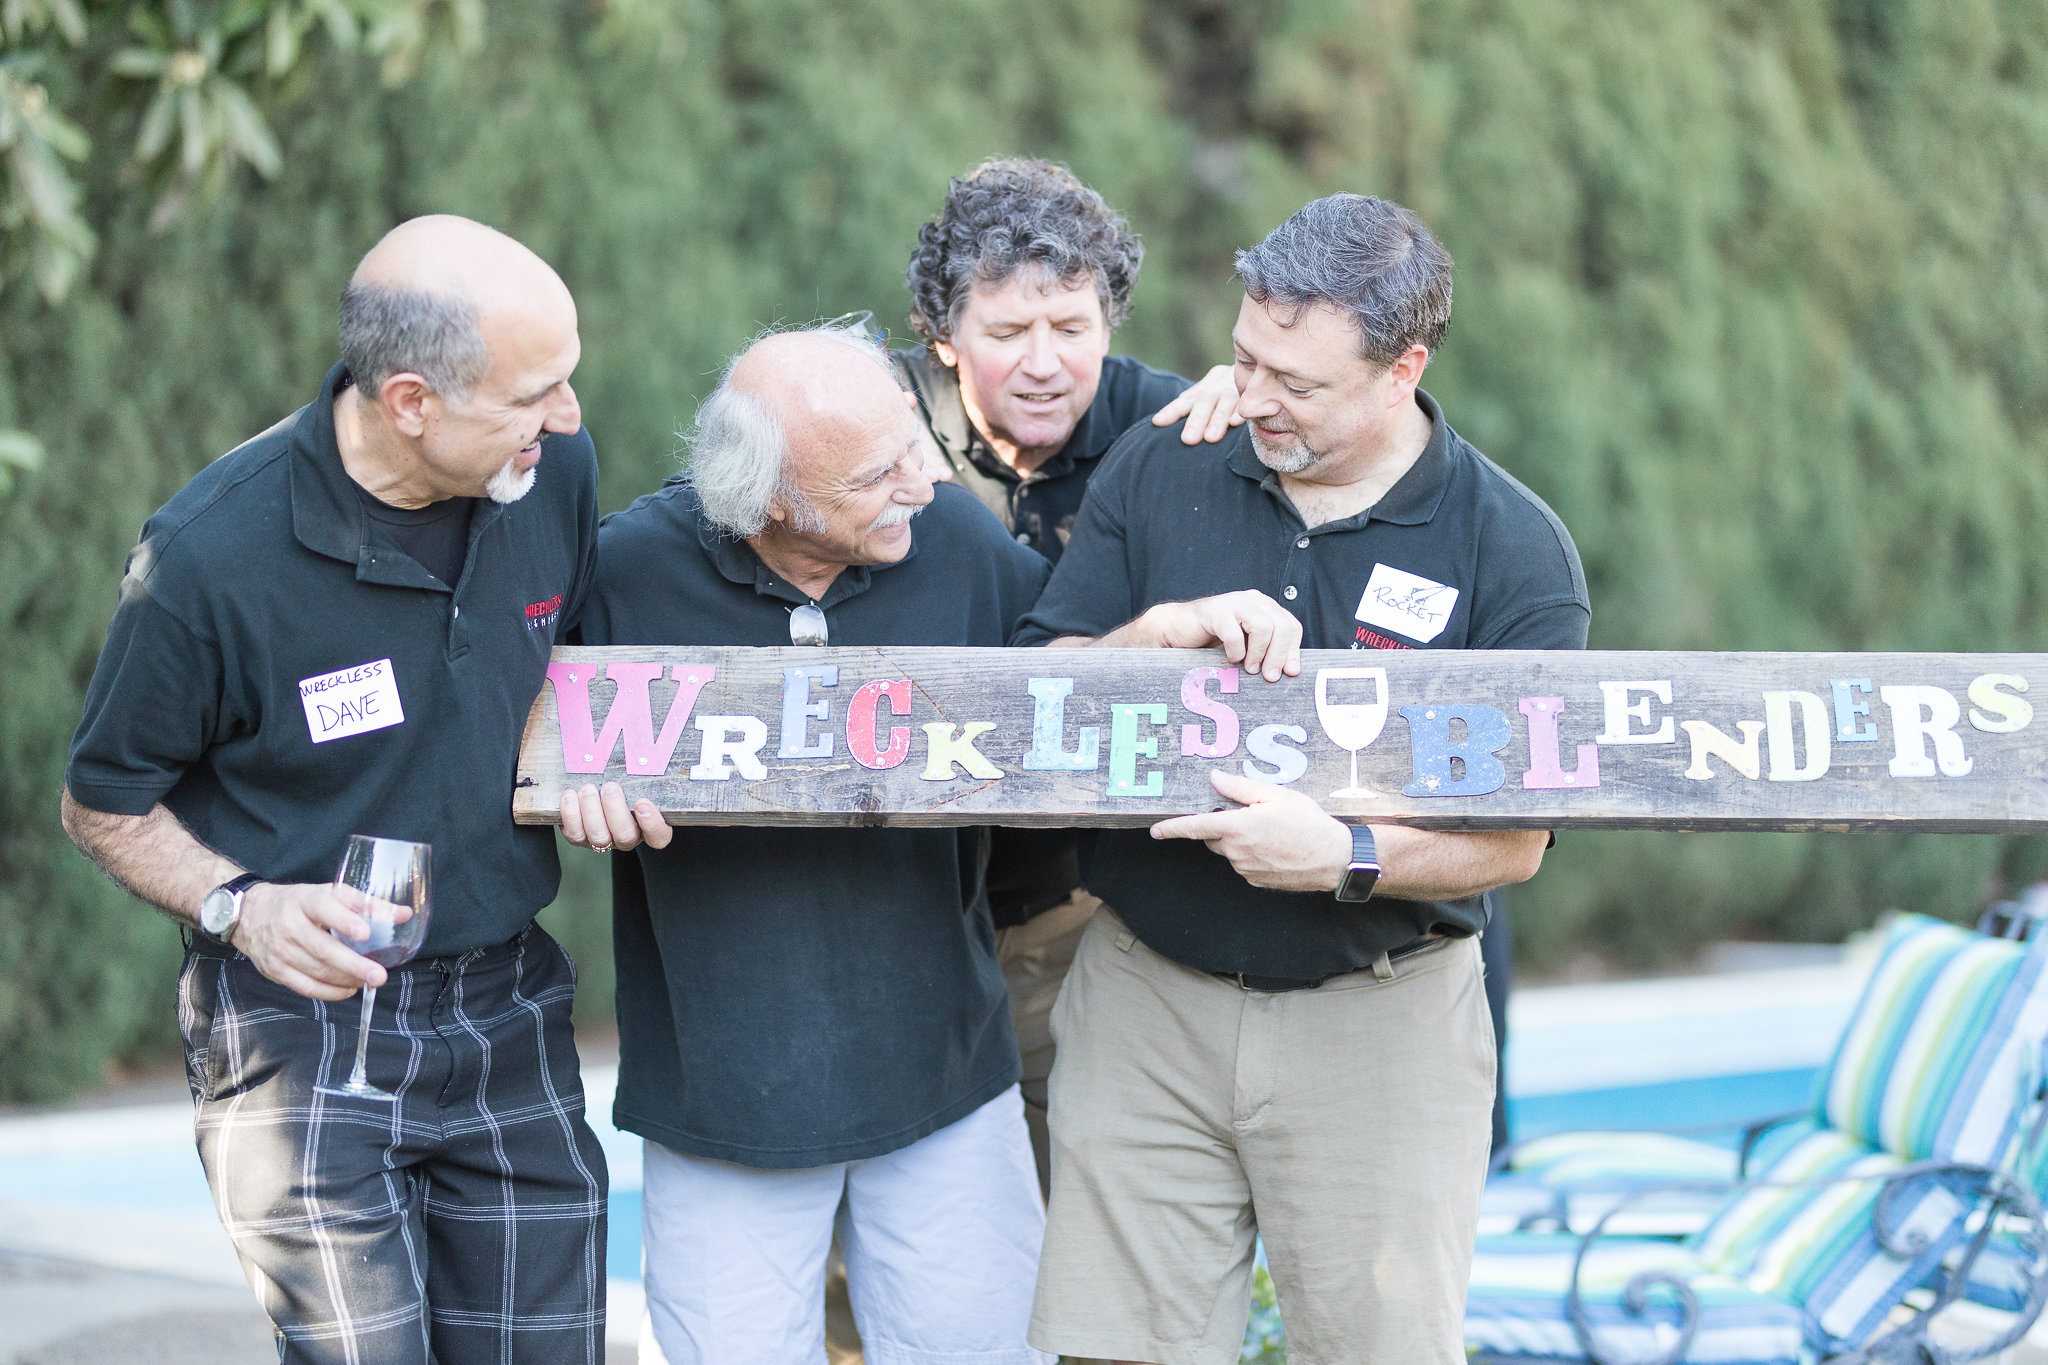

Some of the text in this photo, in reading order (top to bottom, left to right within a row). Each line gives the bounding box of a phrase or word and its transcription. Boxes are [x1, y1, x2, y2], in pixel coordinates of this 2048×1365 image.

[525, 594, 562, 619] WRECKLESS
[1373, 586, 1443, 623] ROCKET
[300, 663, 382, 697] WRECKLESS
[316, 690, 380, 731] DAVE
[546, 662, 2034, 797] WRECKLESS BLENDERS
